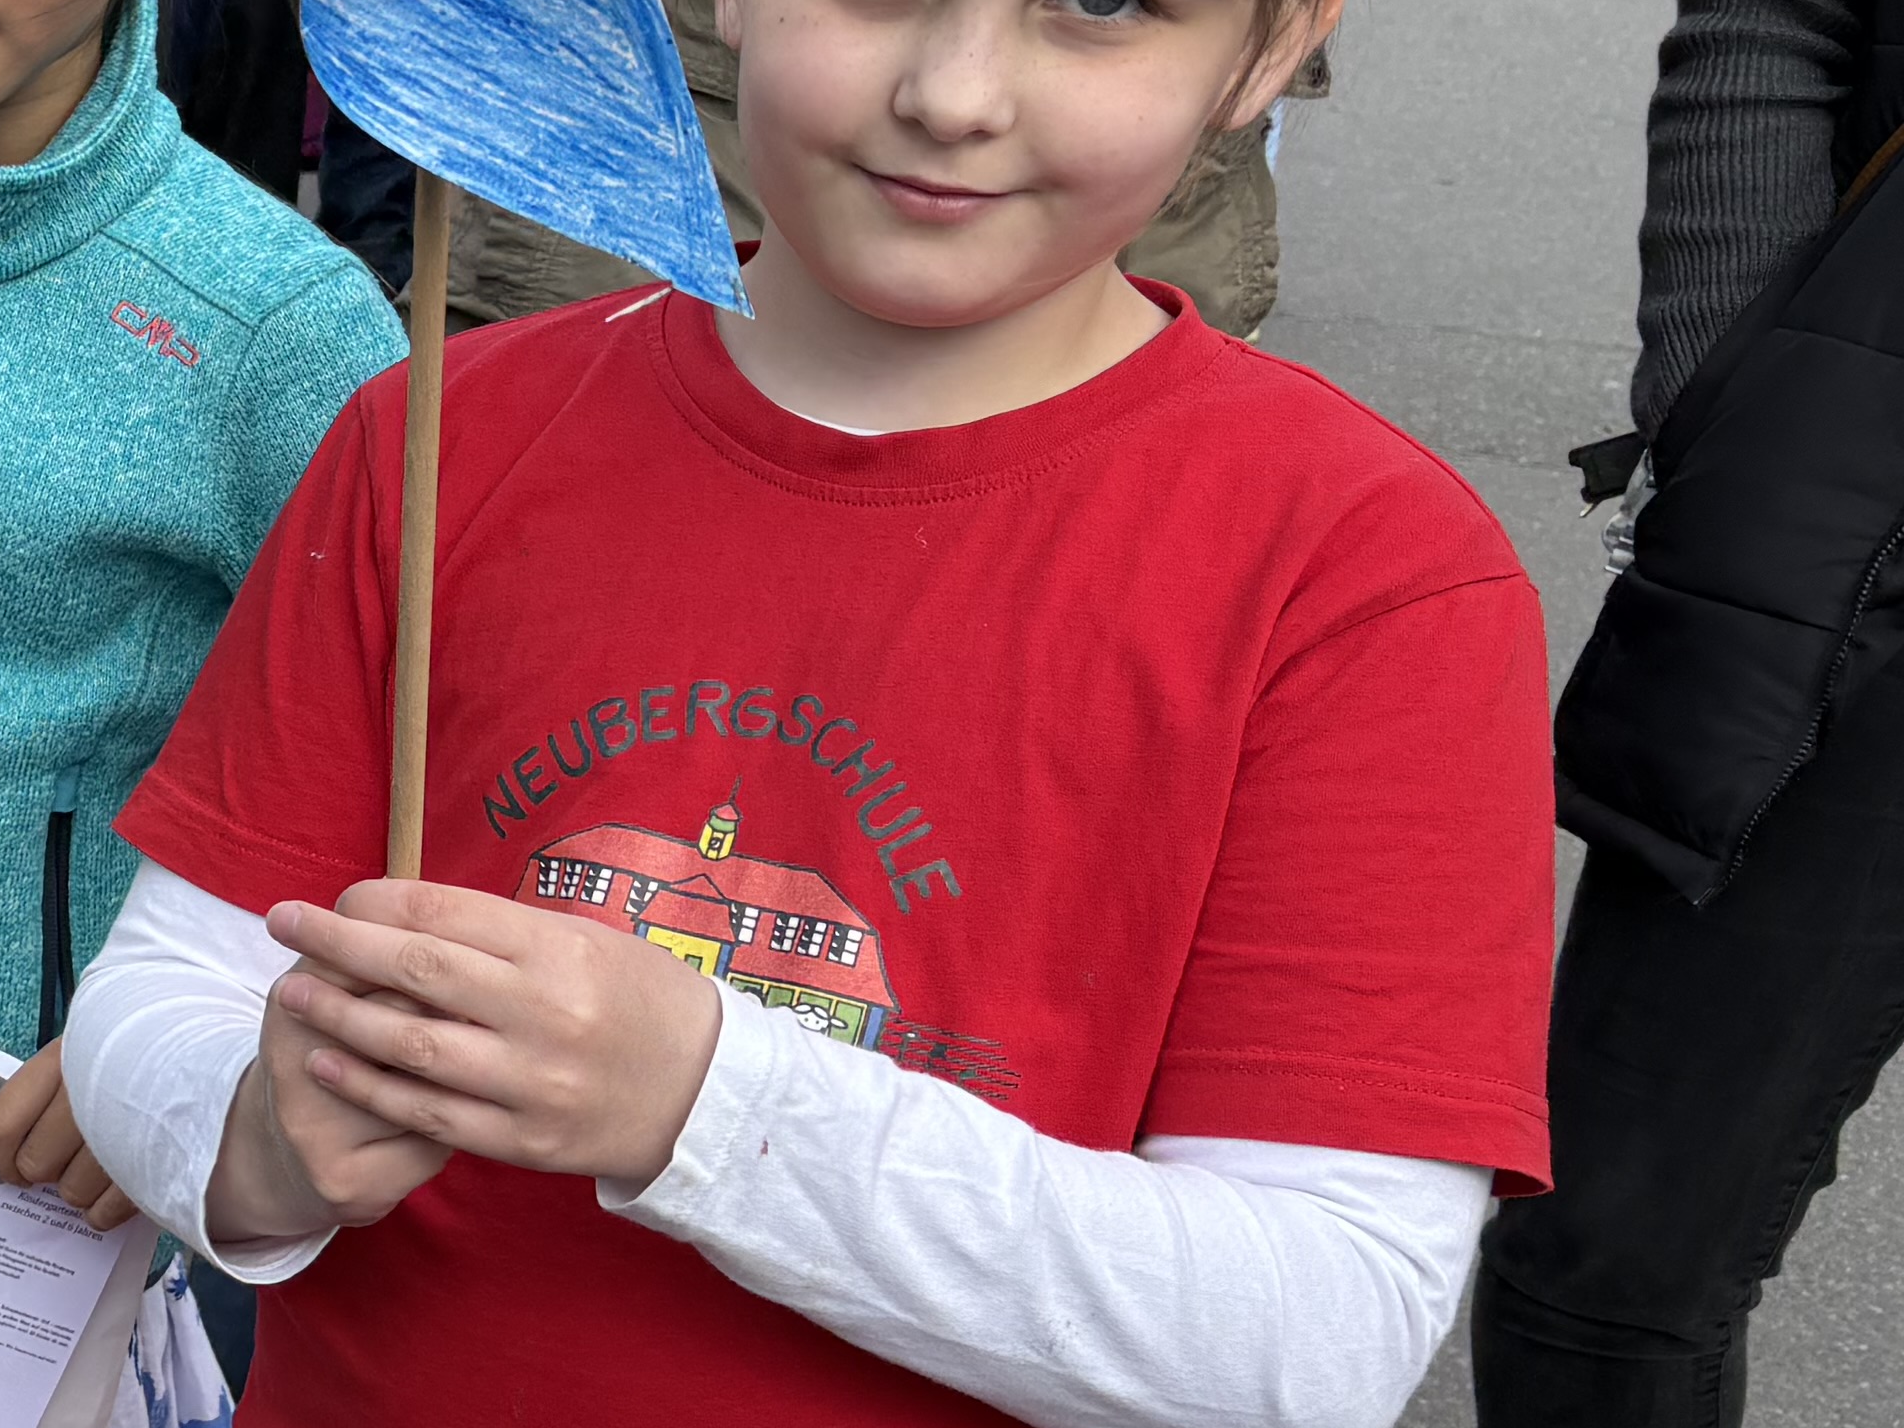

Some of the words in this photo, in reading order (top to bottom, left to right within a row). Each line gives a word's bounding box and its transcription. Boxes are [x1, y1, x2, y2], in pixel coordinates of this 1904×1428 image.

[110, 299, 201, 368] CMP
[481, 679, 963, 915] NEUBERGSCHULE
[0, 1201, 41, 1221] zwischen
